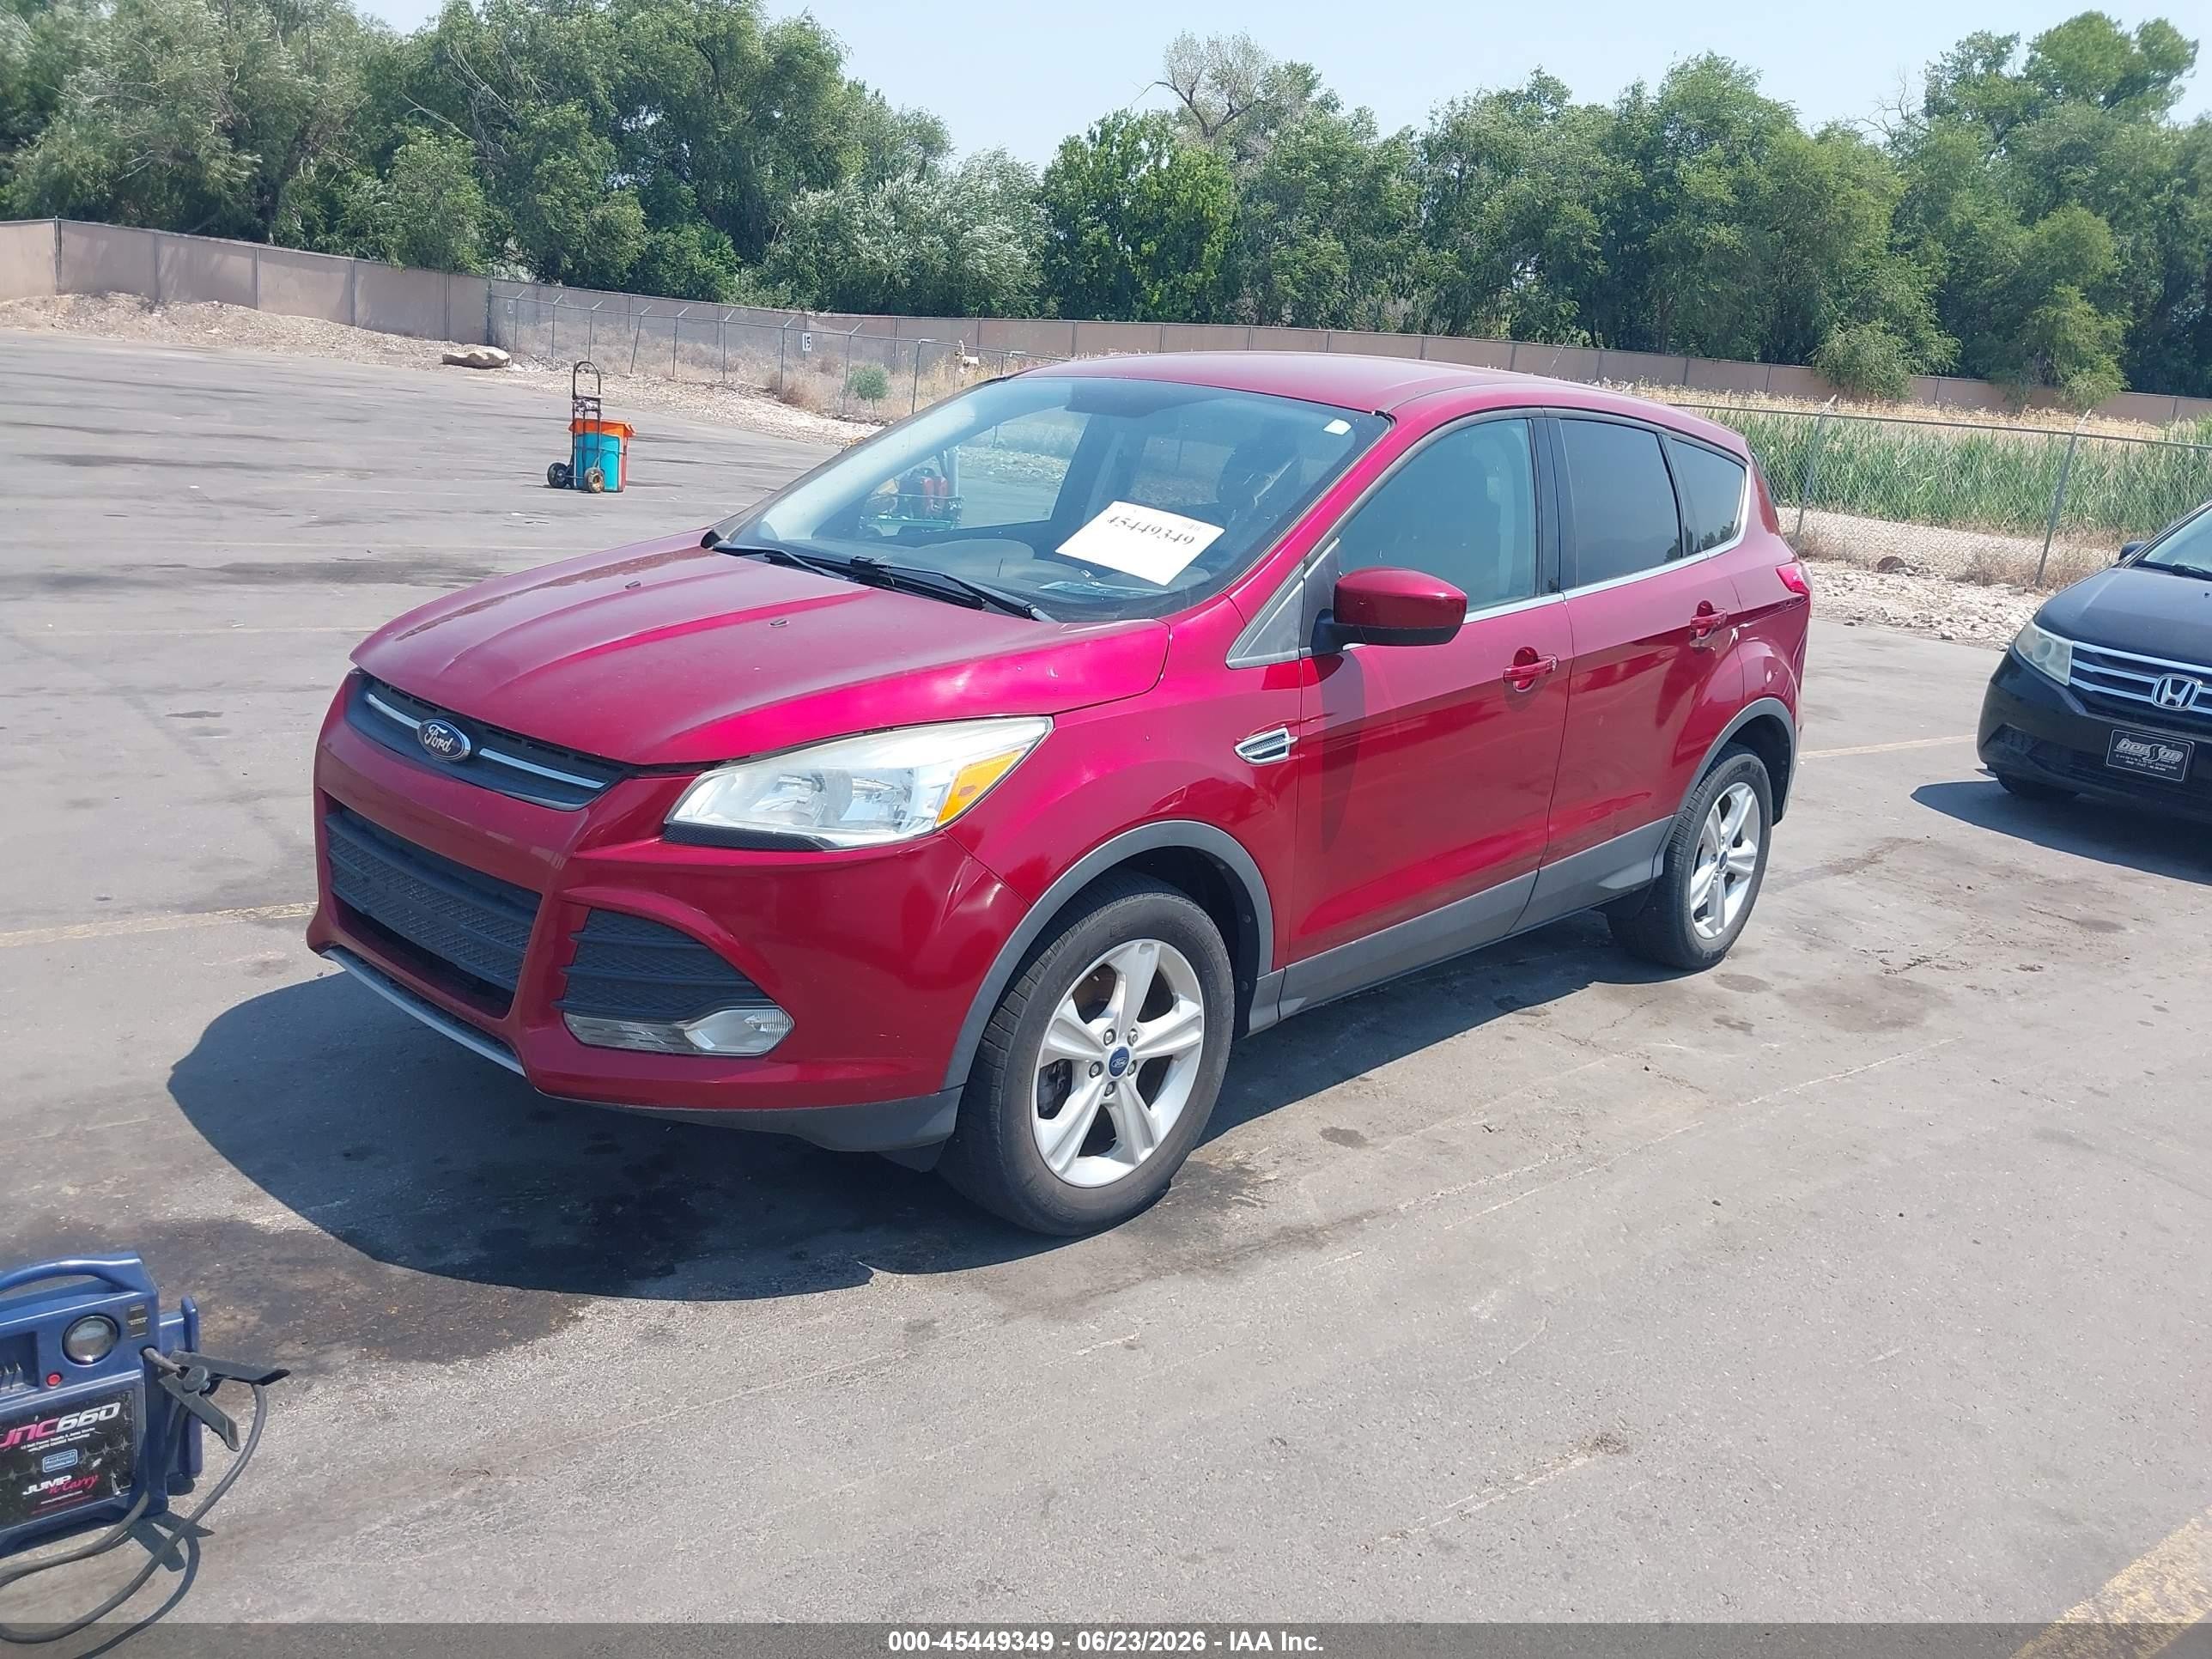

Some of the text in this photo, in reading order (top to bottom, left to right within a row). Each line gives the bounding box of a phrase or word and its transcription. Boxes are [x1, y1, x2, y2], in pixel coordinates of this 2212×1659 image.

[804, 335, 811, 349] 15
[1107, 515, 1195, 544] 45449349
[424, 724, 453, 753] Ford
[22, 1474, 72, 1495] JUMP
